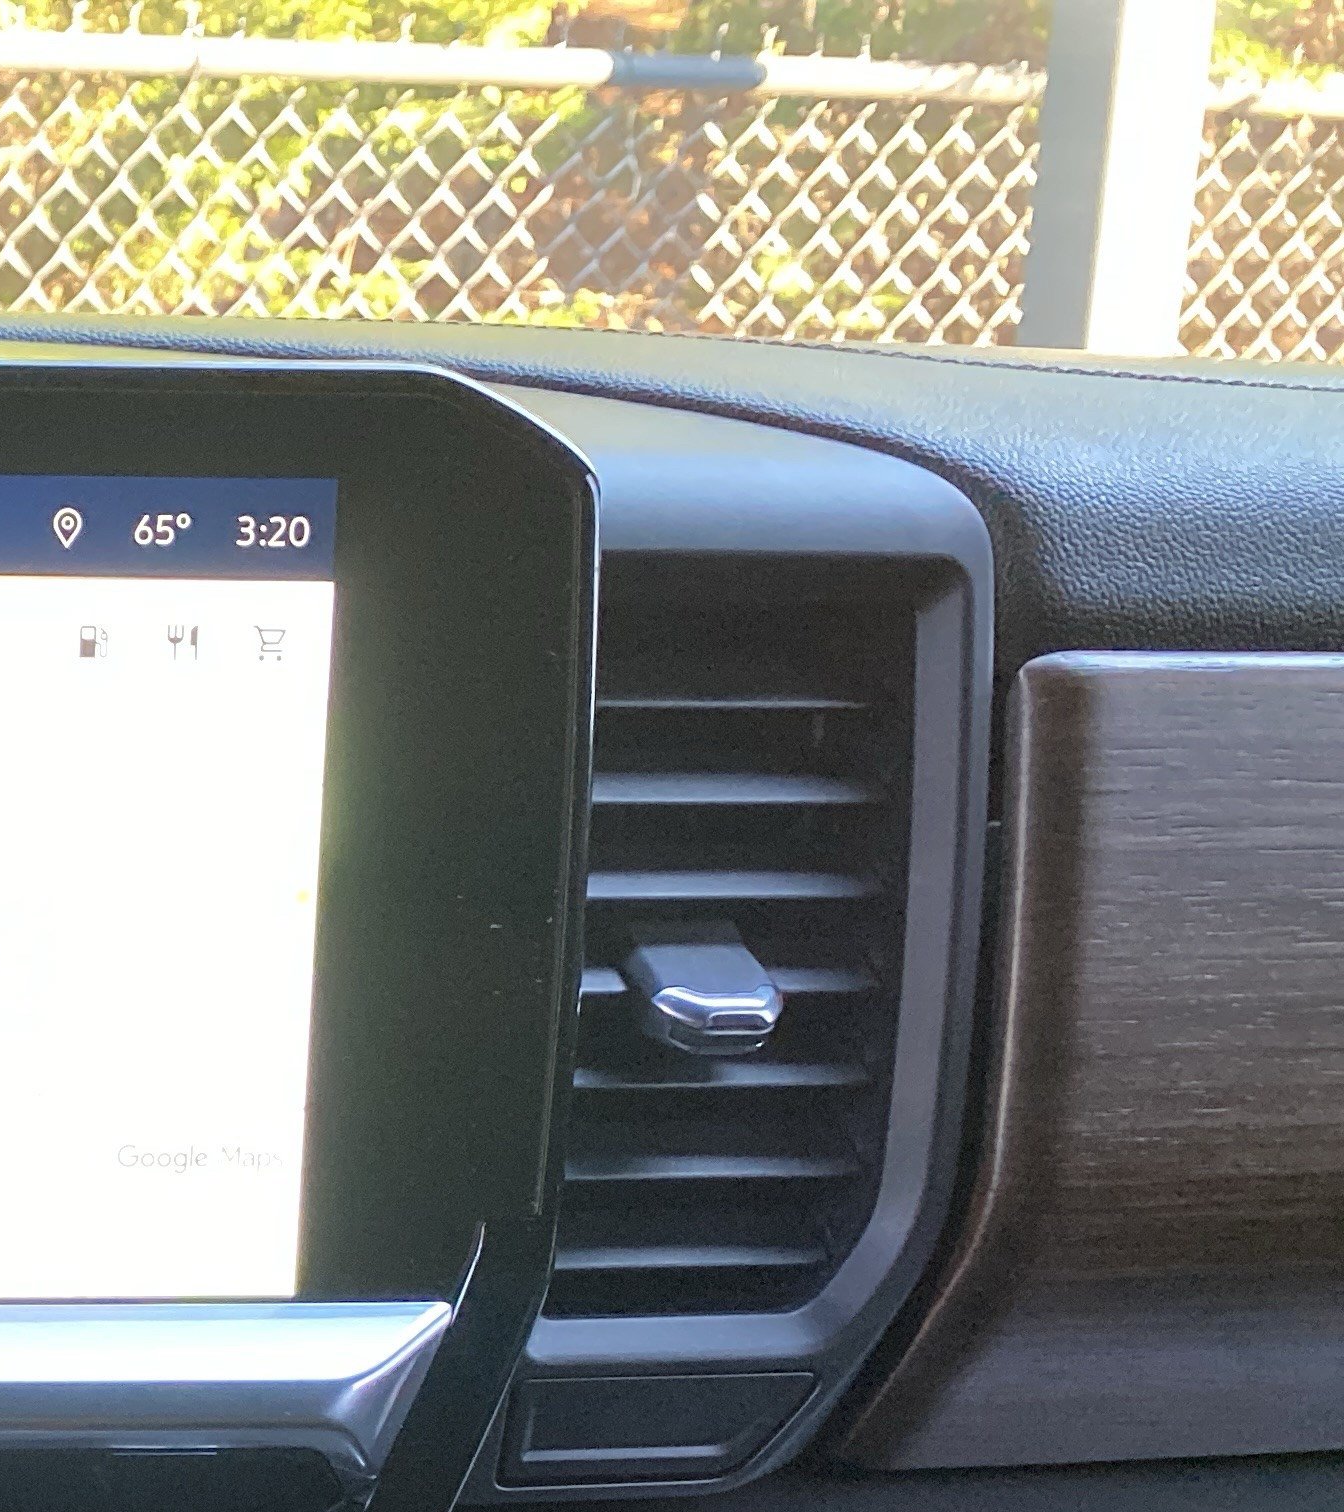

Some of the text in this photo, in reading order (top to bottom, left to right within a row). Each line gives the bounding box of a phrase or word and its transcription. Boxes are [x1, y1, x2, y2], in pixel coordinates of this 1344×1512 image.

[133, 513, 192, 546] 65°
[235, 514, 310, 548] 3:20
[117, 1145, 208, 1173] Google
